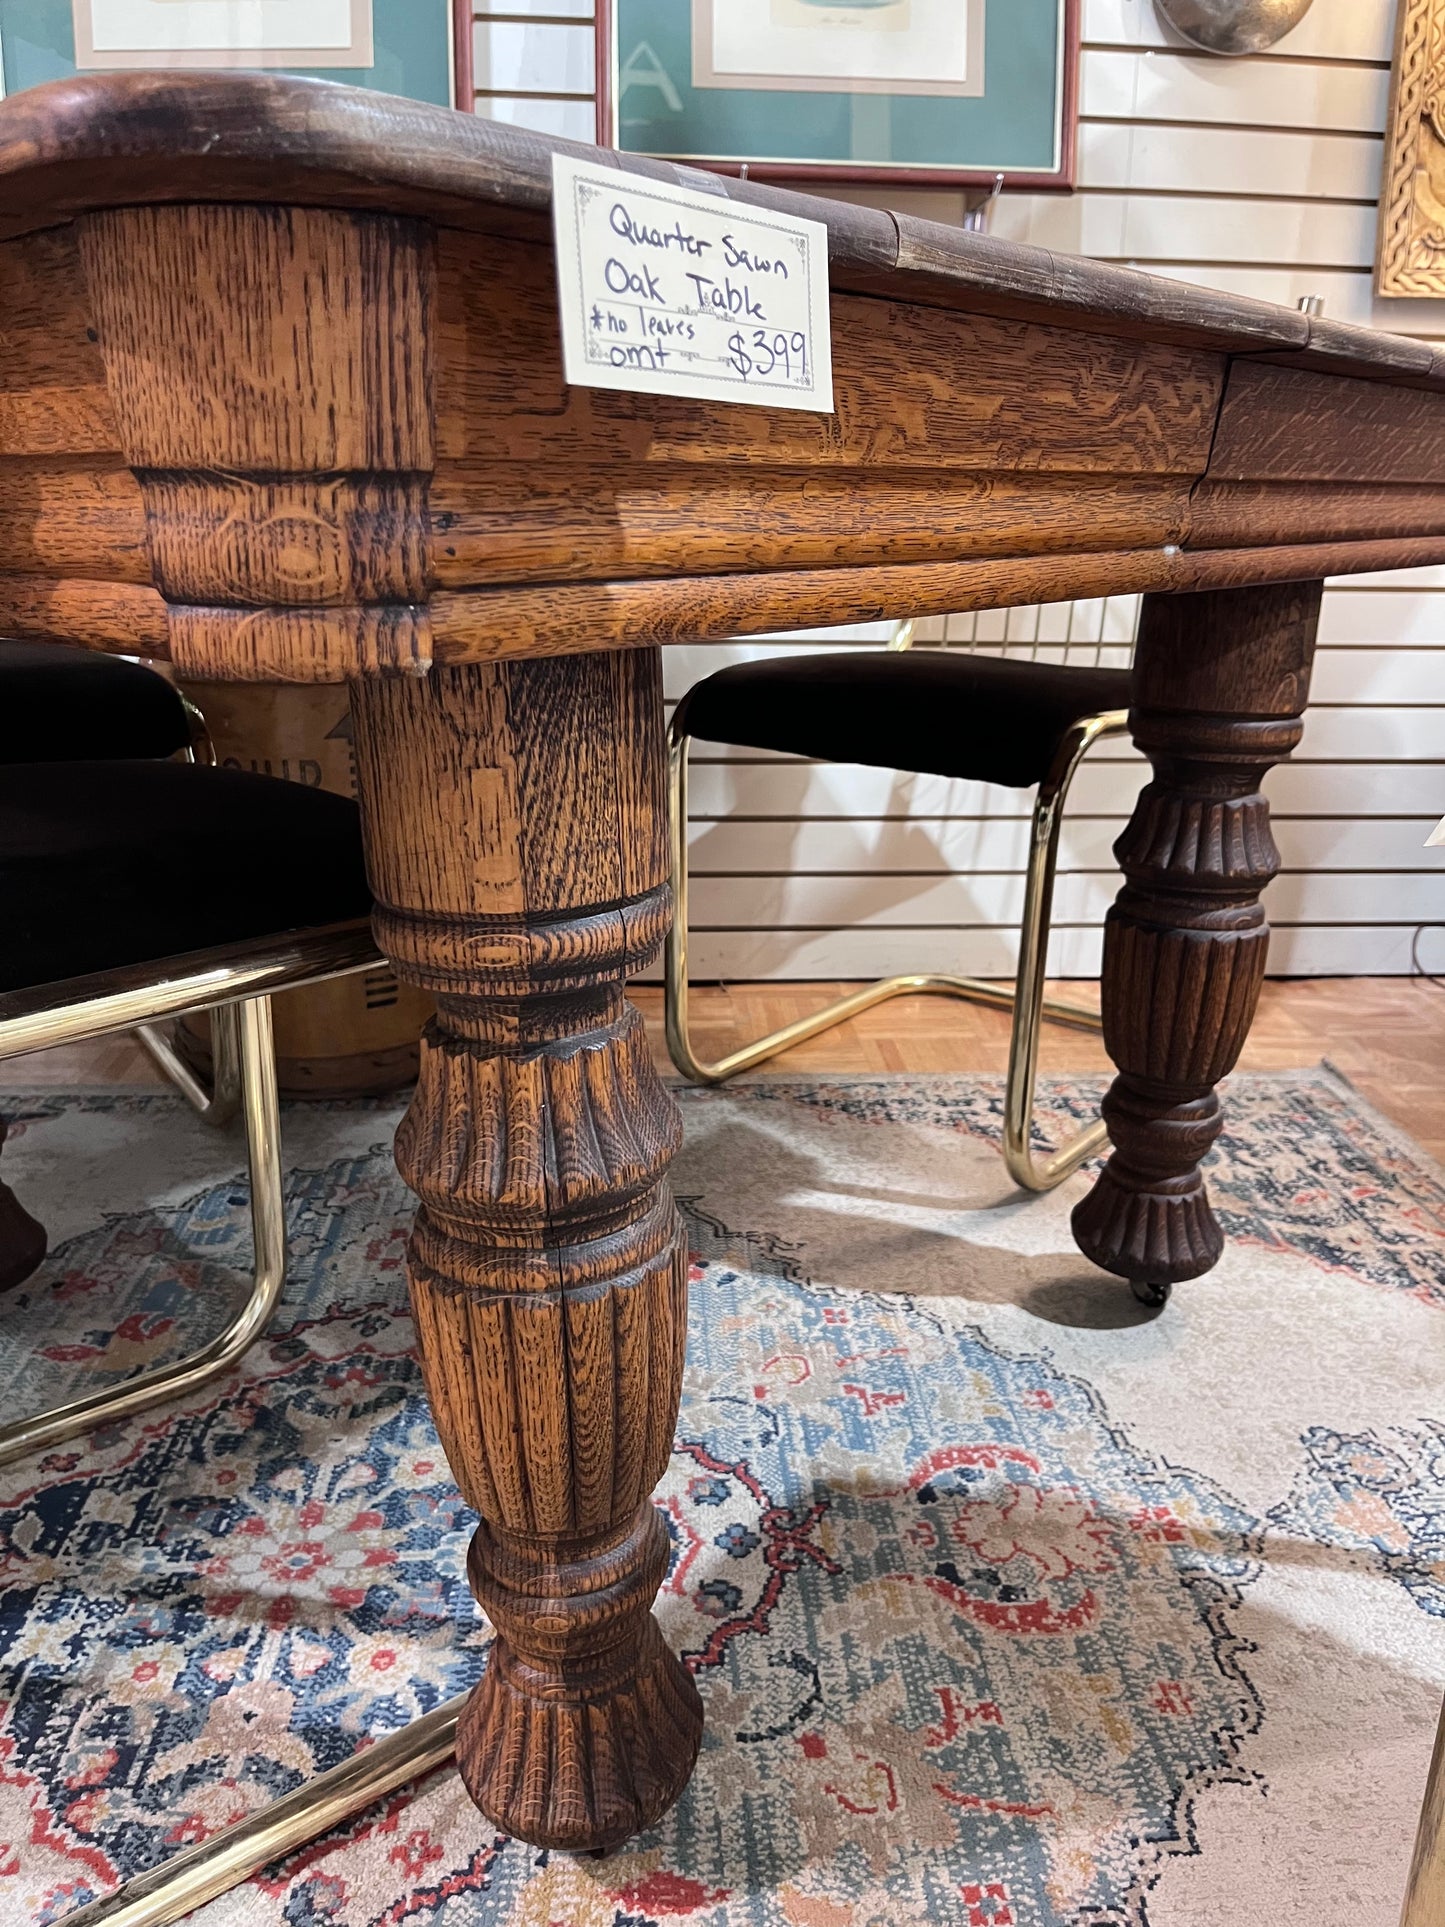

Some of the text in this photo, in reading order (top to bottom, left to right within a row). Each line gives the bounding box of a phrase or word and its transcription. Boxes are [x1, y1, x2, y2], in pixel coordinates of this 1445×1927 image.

[609, 203, 789, 279] Quarter Sawn
[604, 257, 767, 321] Oak Table
[639, 306, 696, 341] leaves
[728, 331, 807, 381] $399
